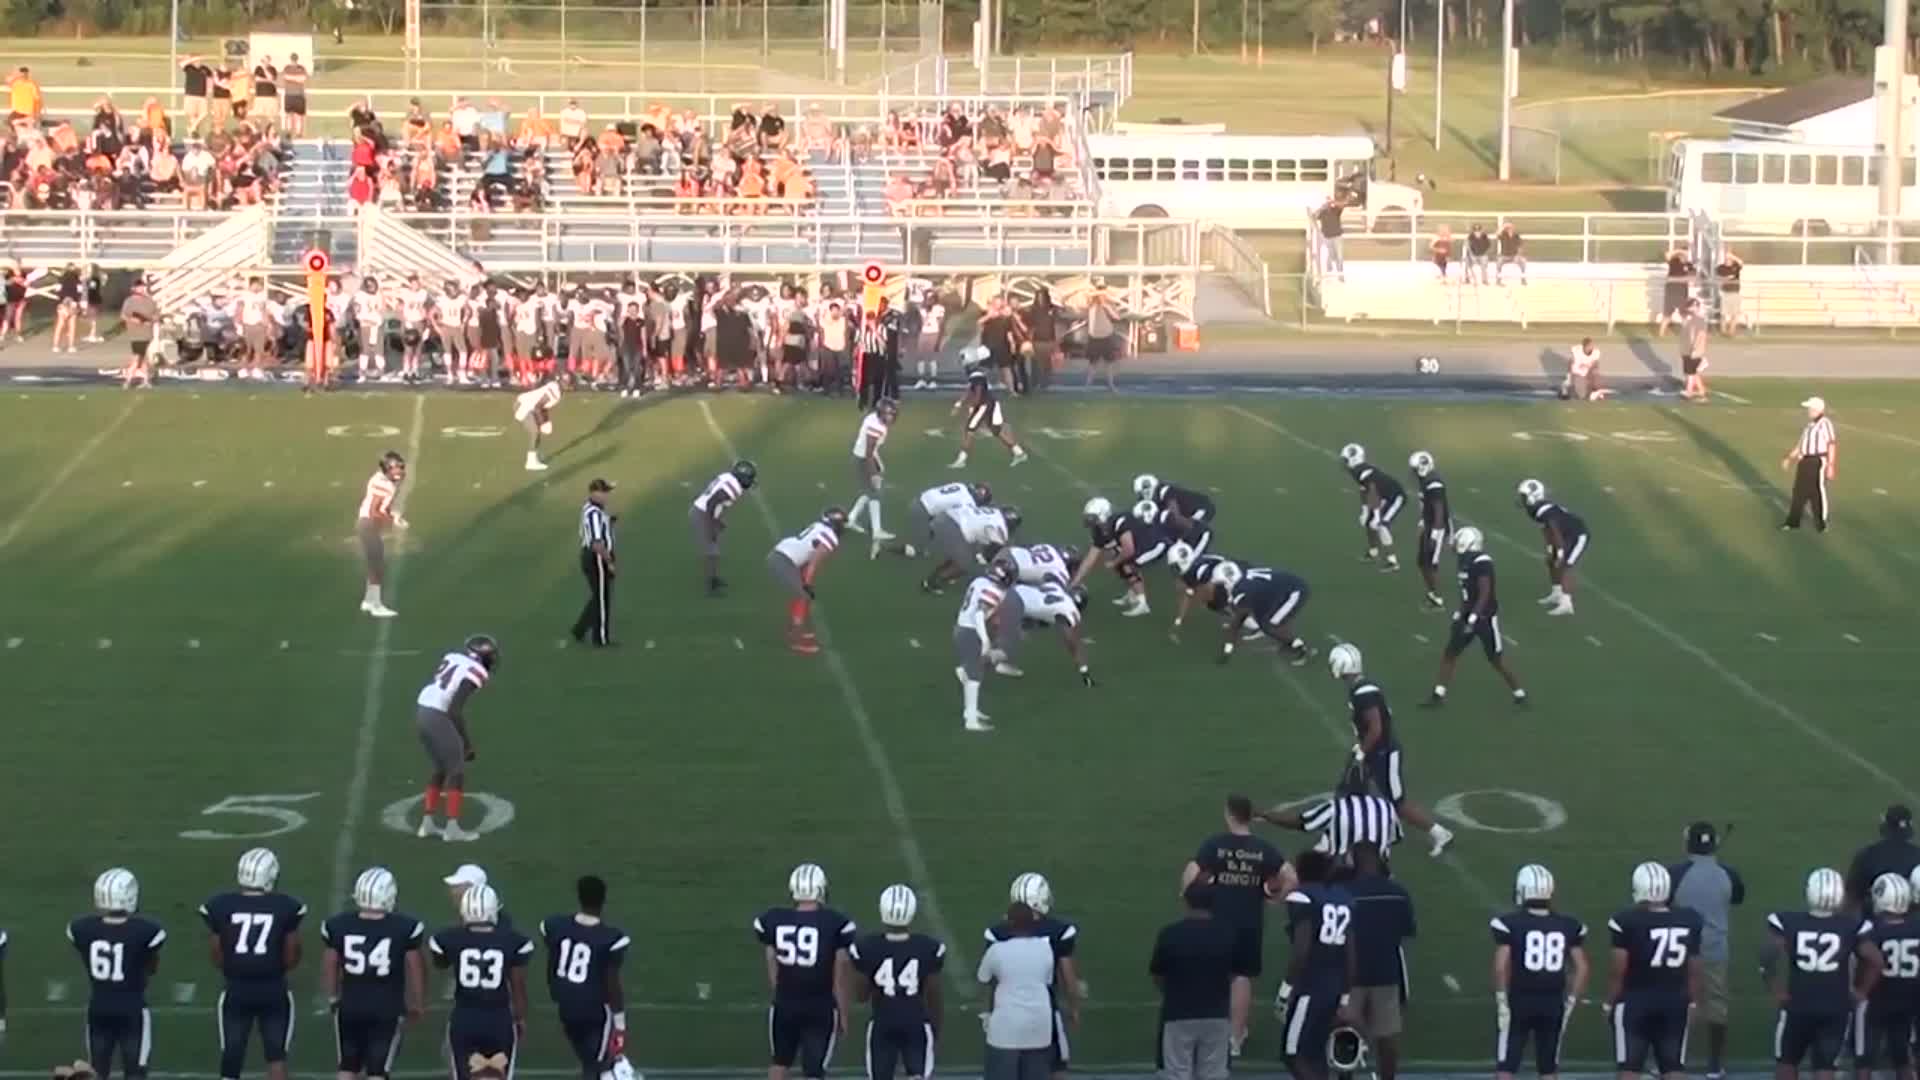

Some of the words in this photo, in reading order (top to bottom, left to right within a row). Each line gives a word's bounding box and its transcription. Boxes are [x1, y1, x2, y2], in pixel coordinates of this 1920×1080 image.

[231, 912, 273, 955] 77
[1319, 903, 1351, 945] 82
[90, 939, 124, 981] 61
[345, 934, 390, 977] 54
[557, 938, 592, 984] 18
[776, 925, 819, 967] 59
[1524, 930, 1566, 972] 88
[1650, 926, 1691, 968] 75
[1796, 930, 1841, 973] 52
[1881, 938, 1920, 979] 35
[459, 948, 504, 989] 63
[874, 957, 920, 996] 44
